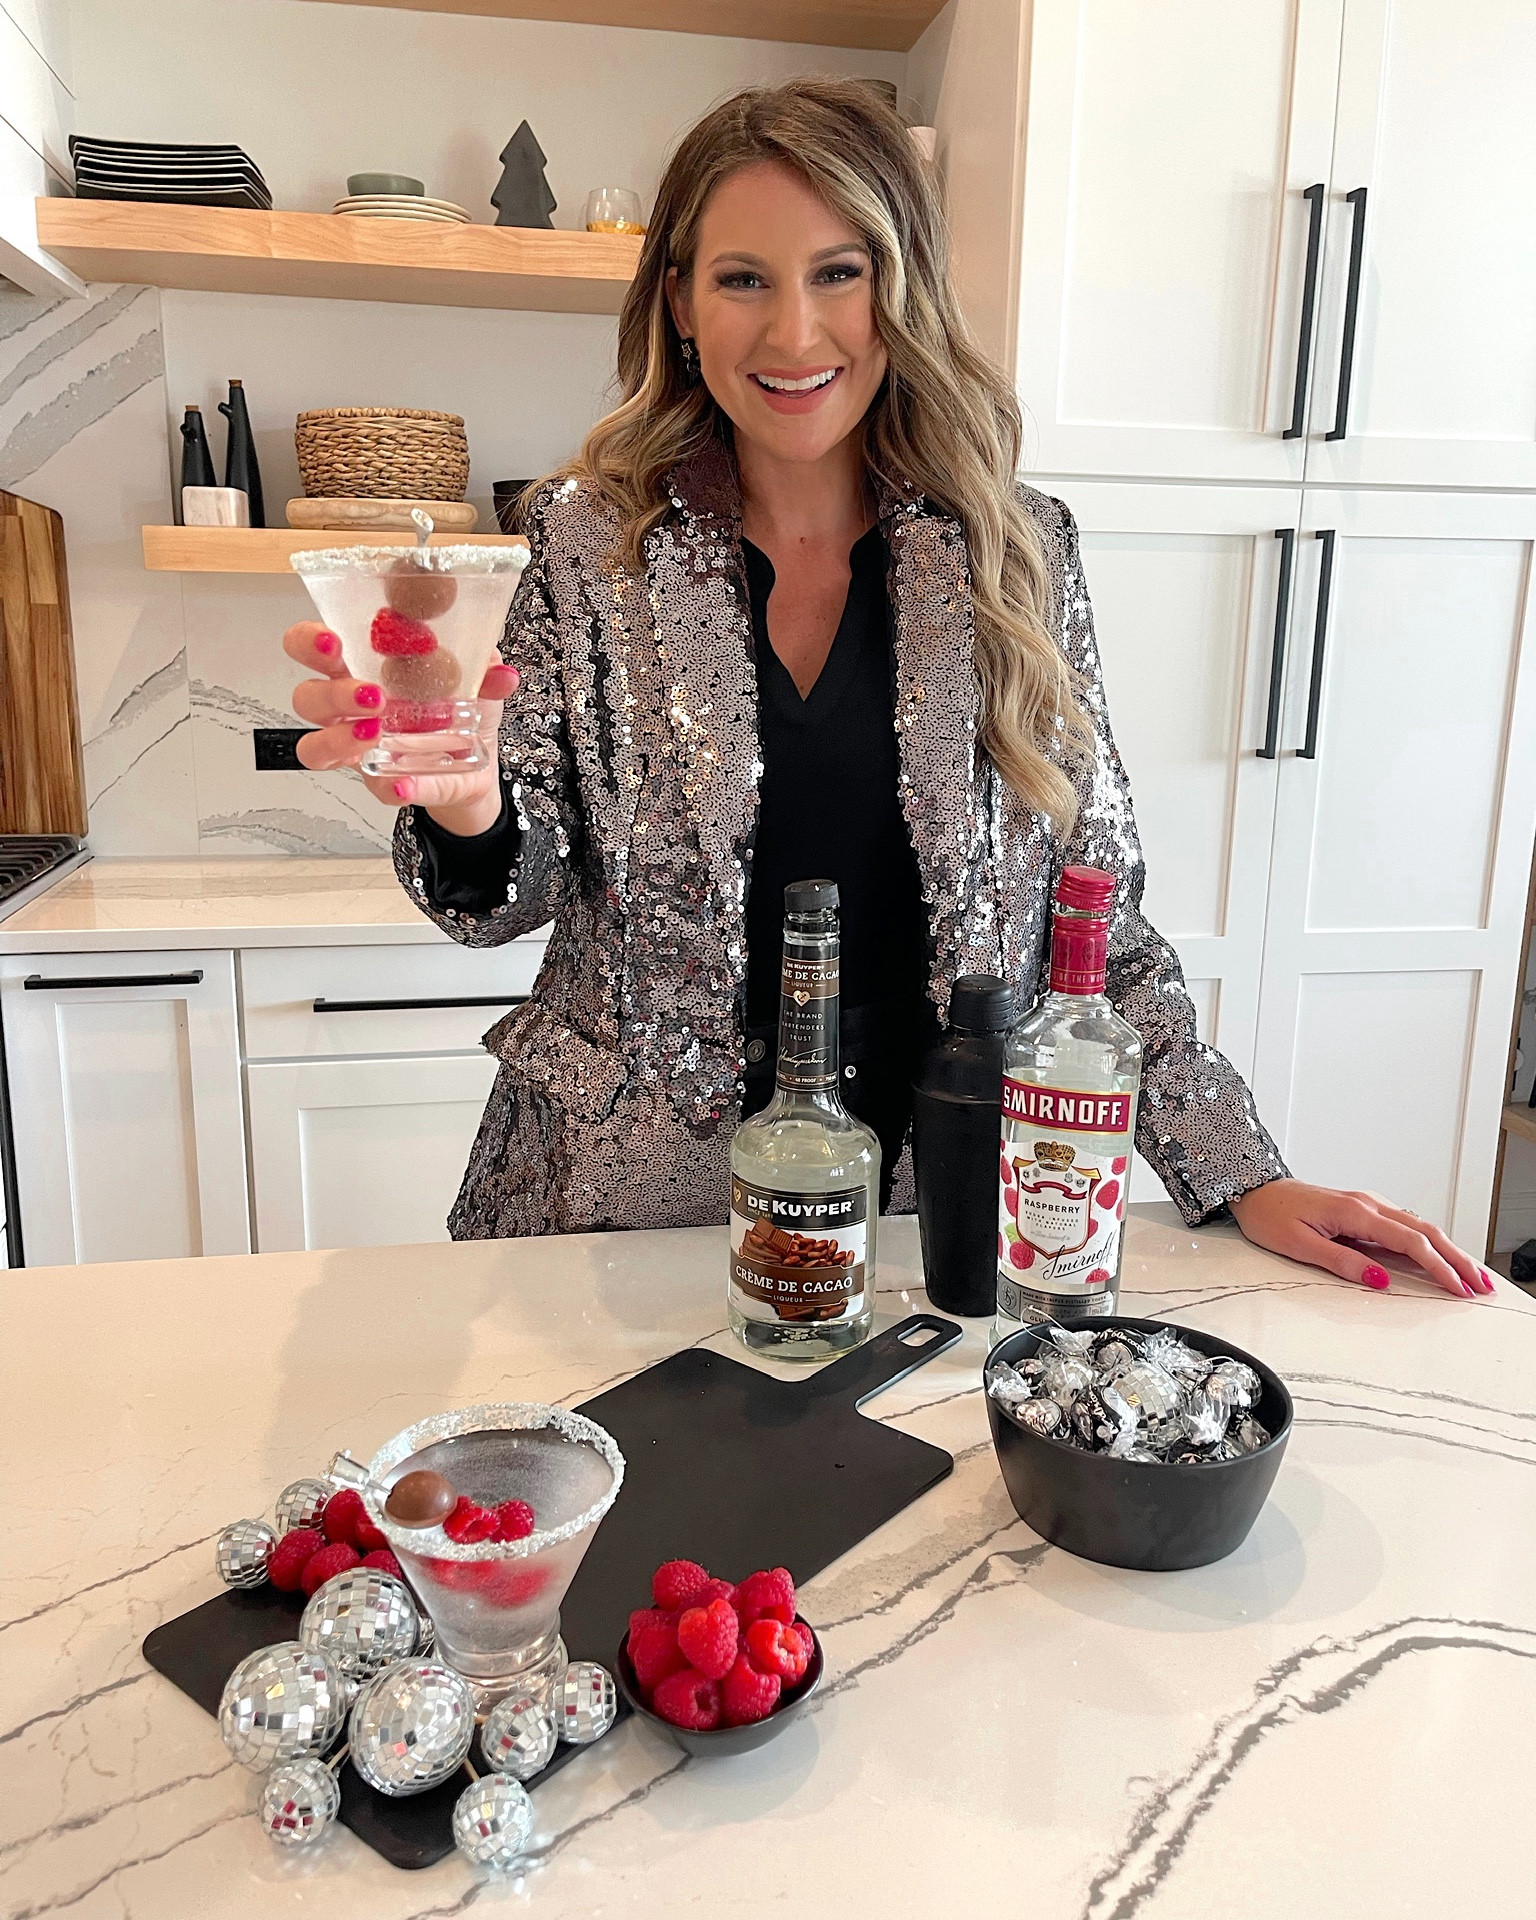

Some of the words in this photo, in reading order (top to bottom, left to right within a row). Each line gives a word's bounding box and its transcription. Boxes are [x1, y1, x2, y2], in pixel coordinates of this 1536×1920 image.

[794, 971, 809, 980] DE
[1071, 974, 1086, 984] THE
[796, 1012, 823, 1020] BRAND
[790, 1033, 812, 1042] TRUST
[747, 1194, 769, 1212] DE
[772, 1199, 853, 1217] KUYPER
[1024, 1198, 1080, 1214] RASPBERRY
[1042, 1229, 1117, 1280] Smirnoff
[735, 1265, 774, 1290] CRÈME
[777, 1280, 798, 1293] DE
[802, 1276, 853, 1294] CACAO
[773, 1295, 803, 1303] LIQUEUR
